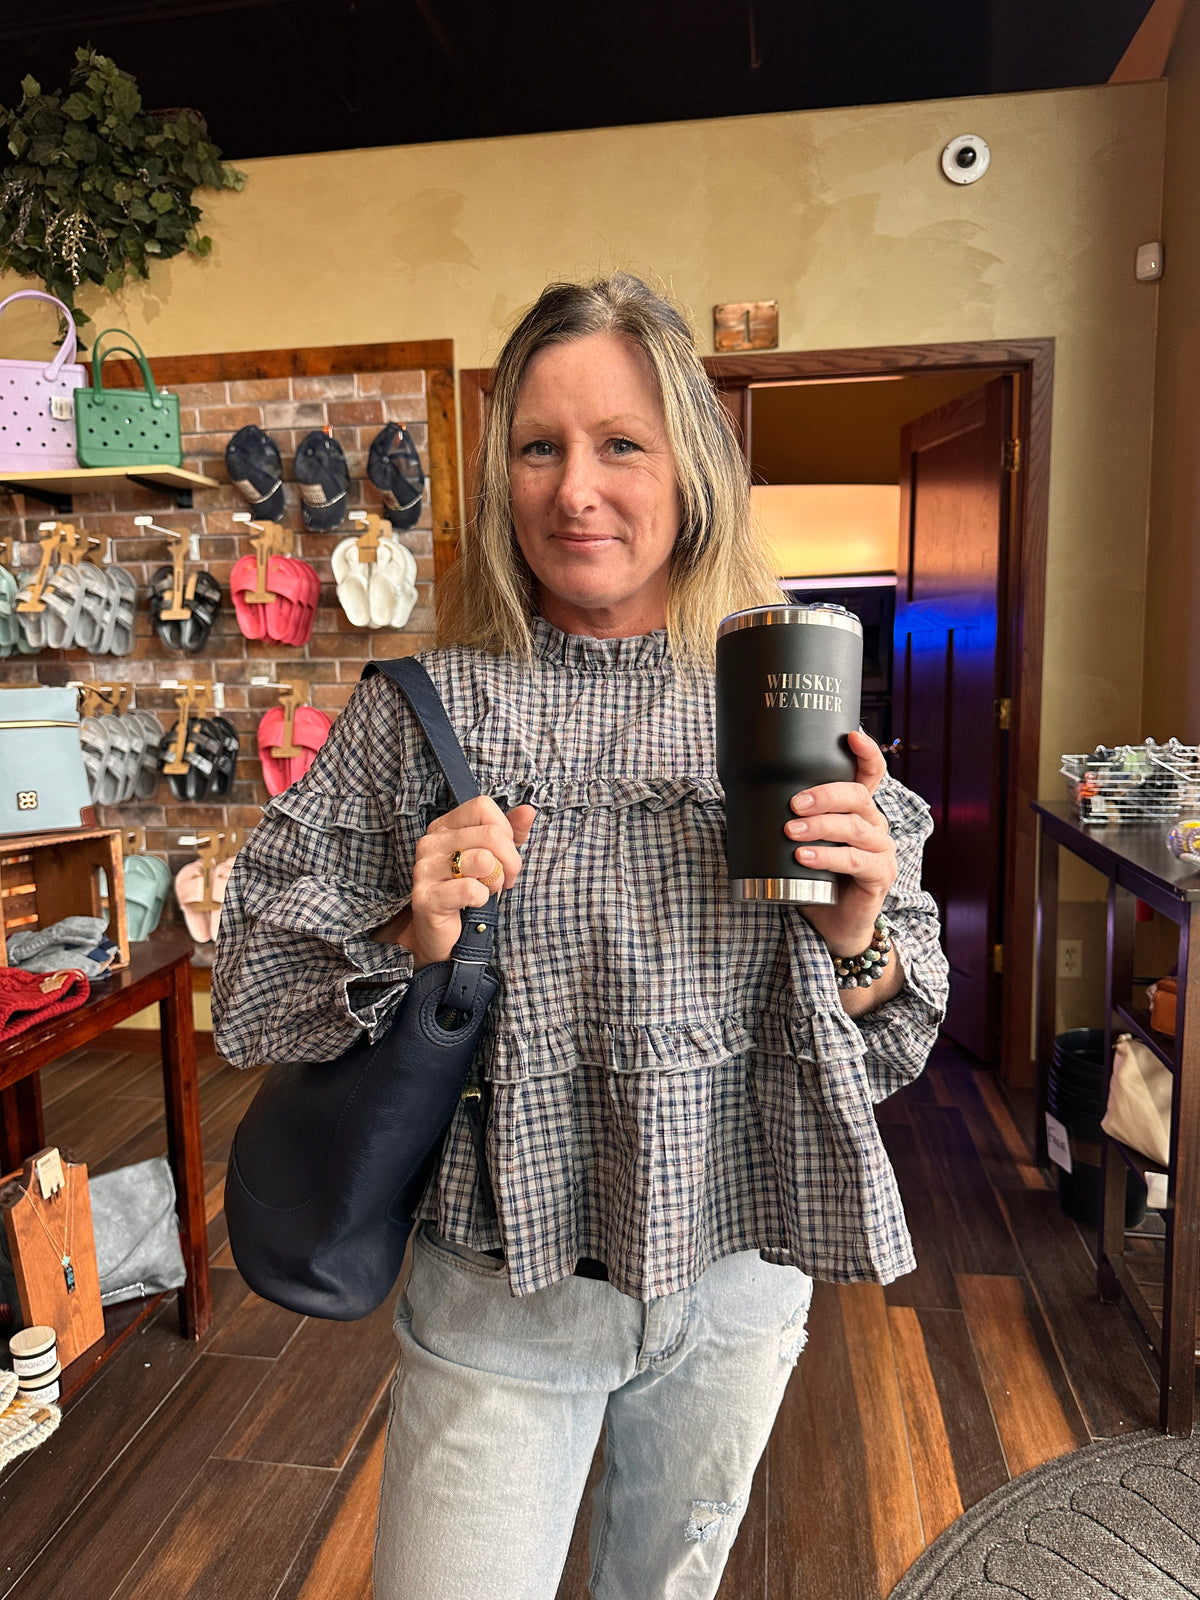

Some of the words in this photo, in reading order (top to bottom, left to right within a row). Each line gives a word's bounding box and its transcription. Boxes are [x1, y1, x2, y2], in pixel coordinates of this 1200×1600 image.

[767, 673, 842, 694] WHISKEY
[764, 692, 842, 712] WEATHER
[18, 1355, 53, 1369] MAGNOLIA
